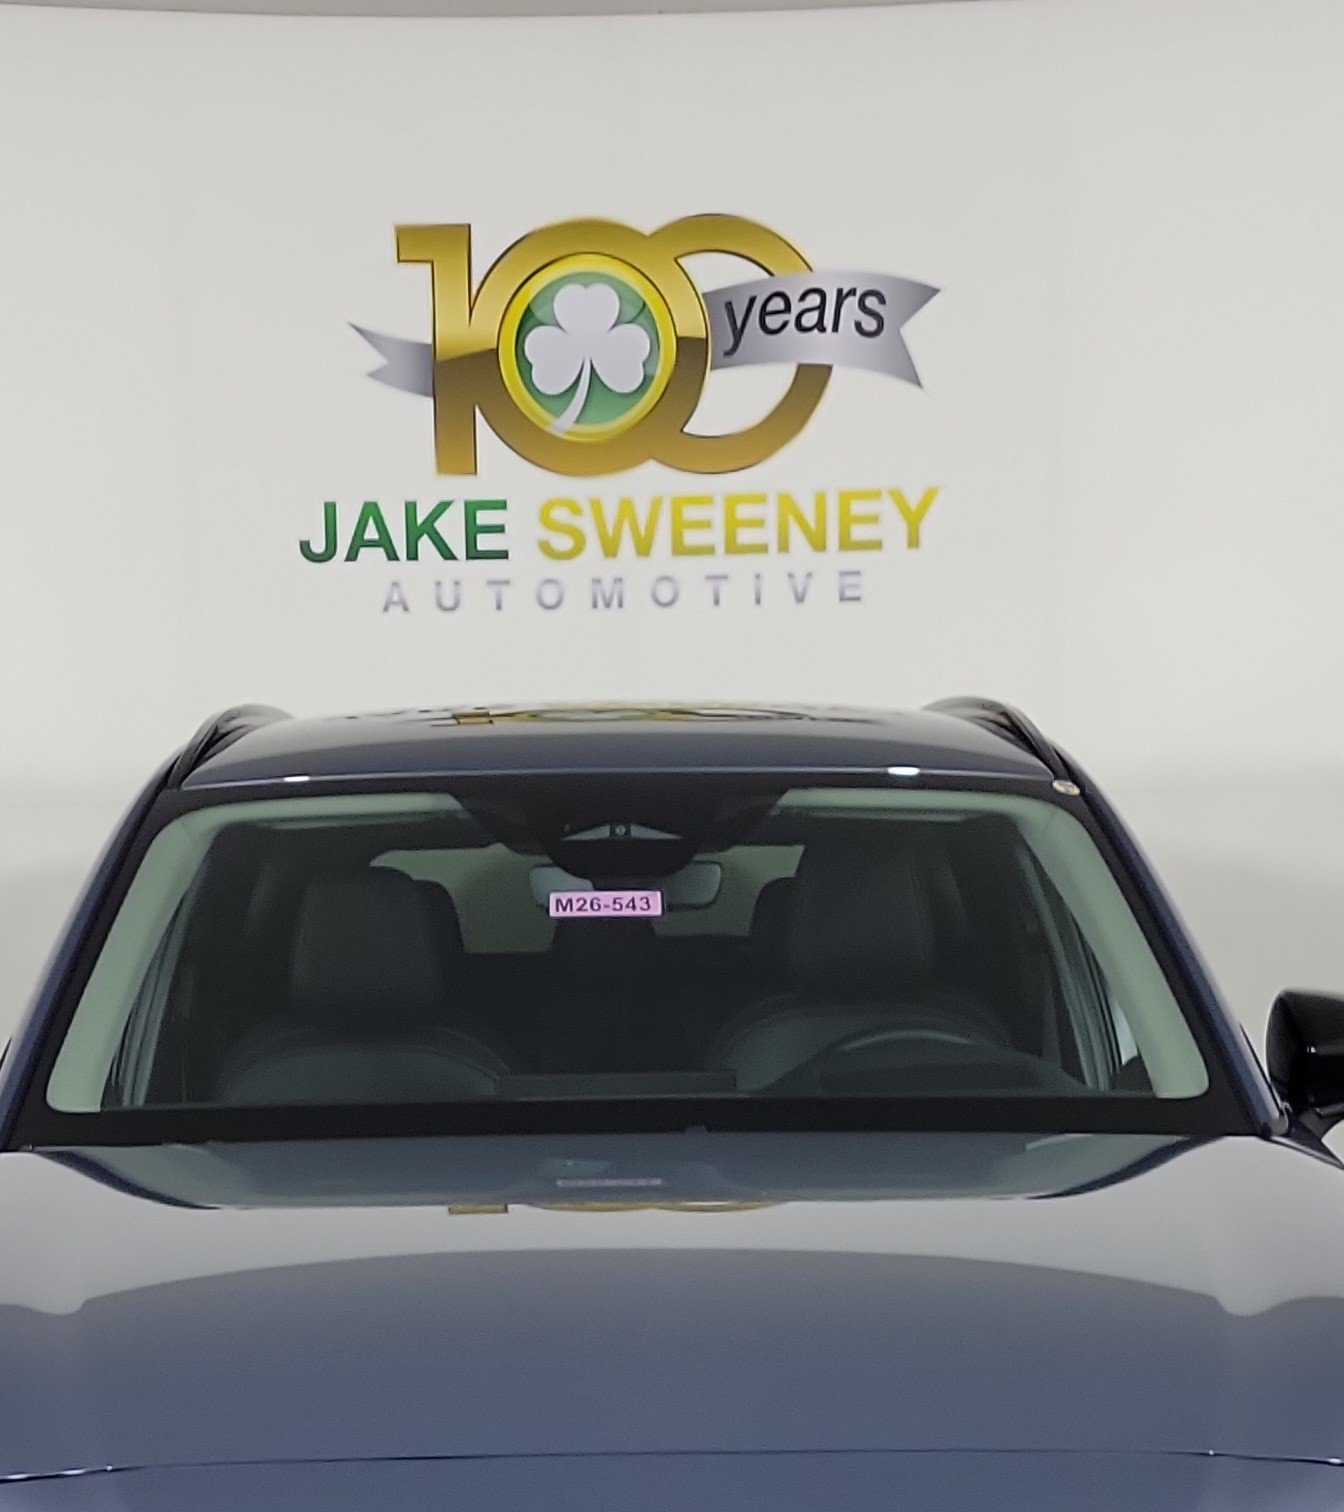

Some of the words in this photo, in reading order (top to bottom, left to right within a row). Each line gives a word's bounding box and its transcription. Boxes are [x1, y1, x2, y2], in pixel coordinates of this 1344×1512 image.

[723, 286, 888, 357] years
[299, 499, 510, 564] JAKE
[536, 487, 941, 561] SWEENEY
[382, 571, 864, 613] AUTOMOTIVE
[555, 896, 651, 912] M26-543
